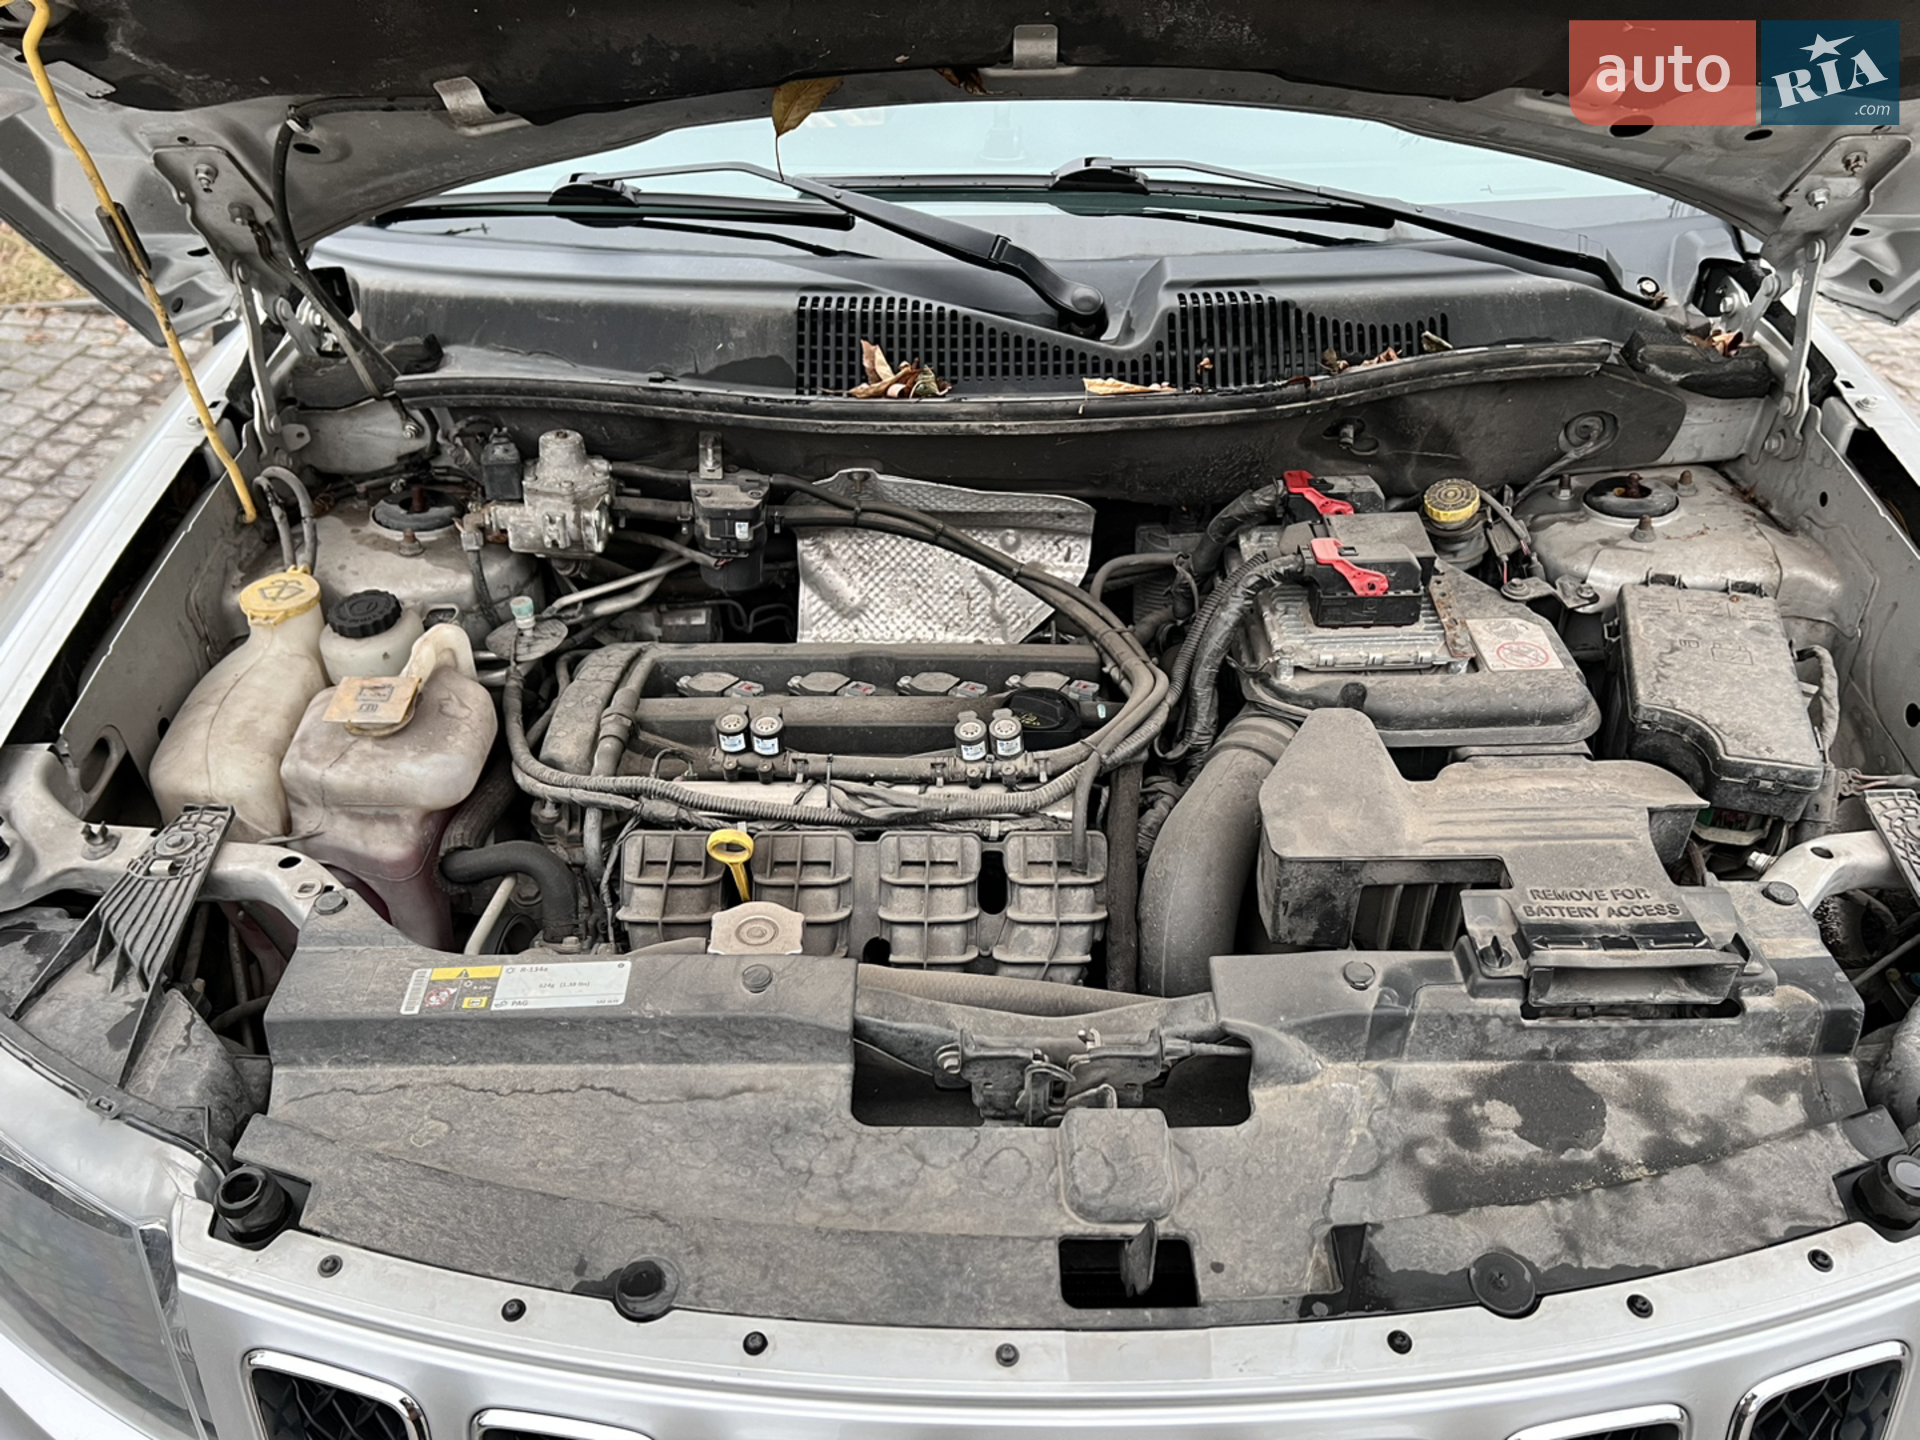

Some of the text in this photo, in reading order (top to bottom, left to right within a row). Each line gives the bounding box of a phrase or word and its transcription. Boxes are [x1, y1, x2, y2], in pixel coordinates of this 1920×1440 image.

[1528, 887, 1651, 901] REMOVE FOR
[1522, 903, 1681, 919] BATTERY ACCESS
[511, 999, 529, 1007] PAG
